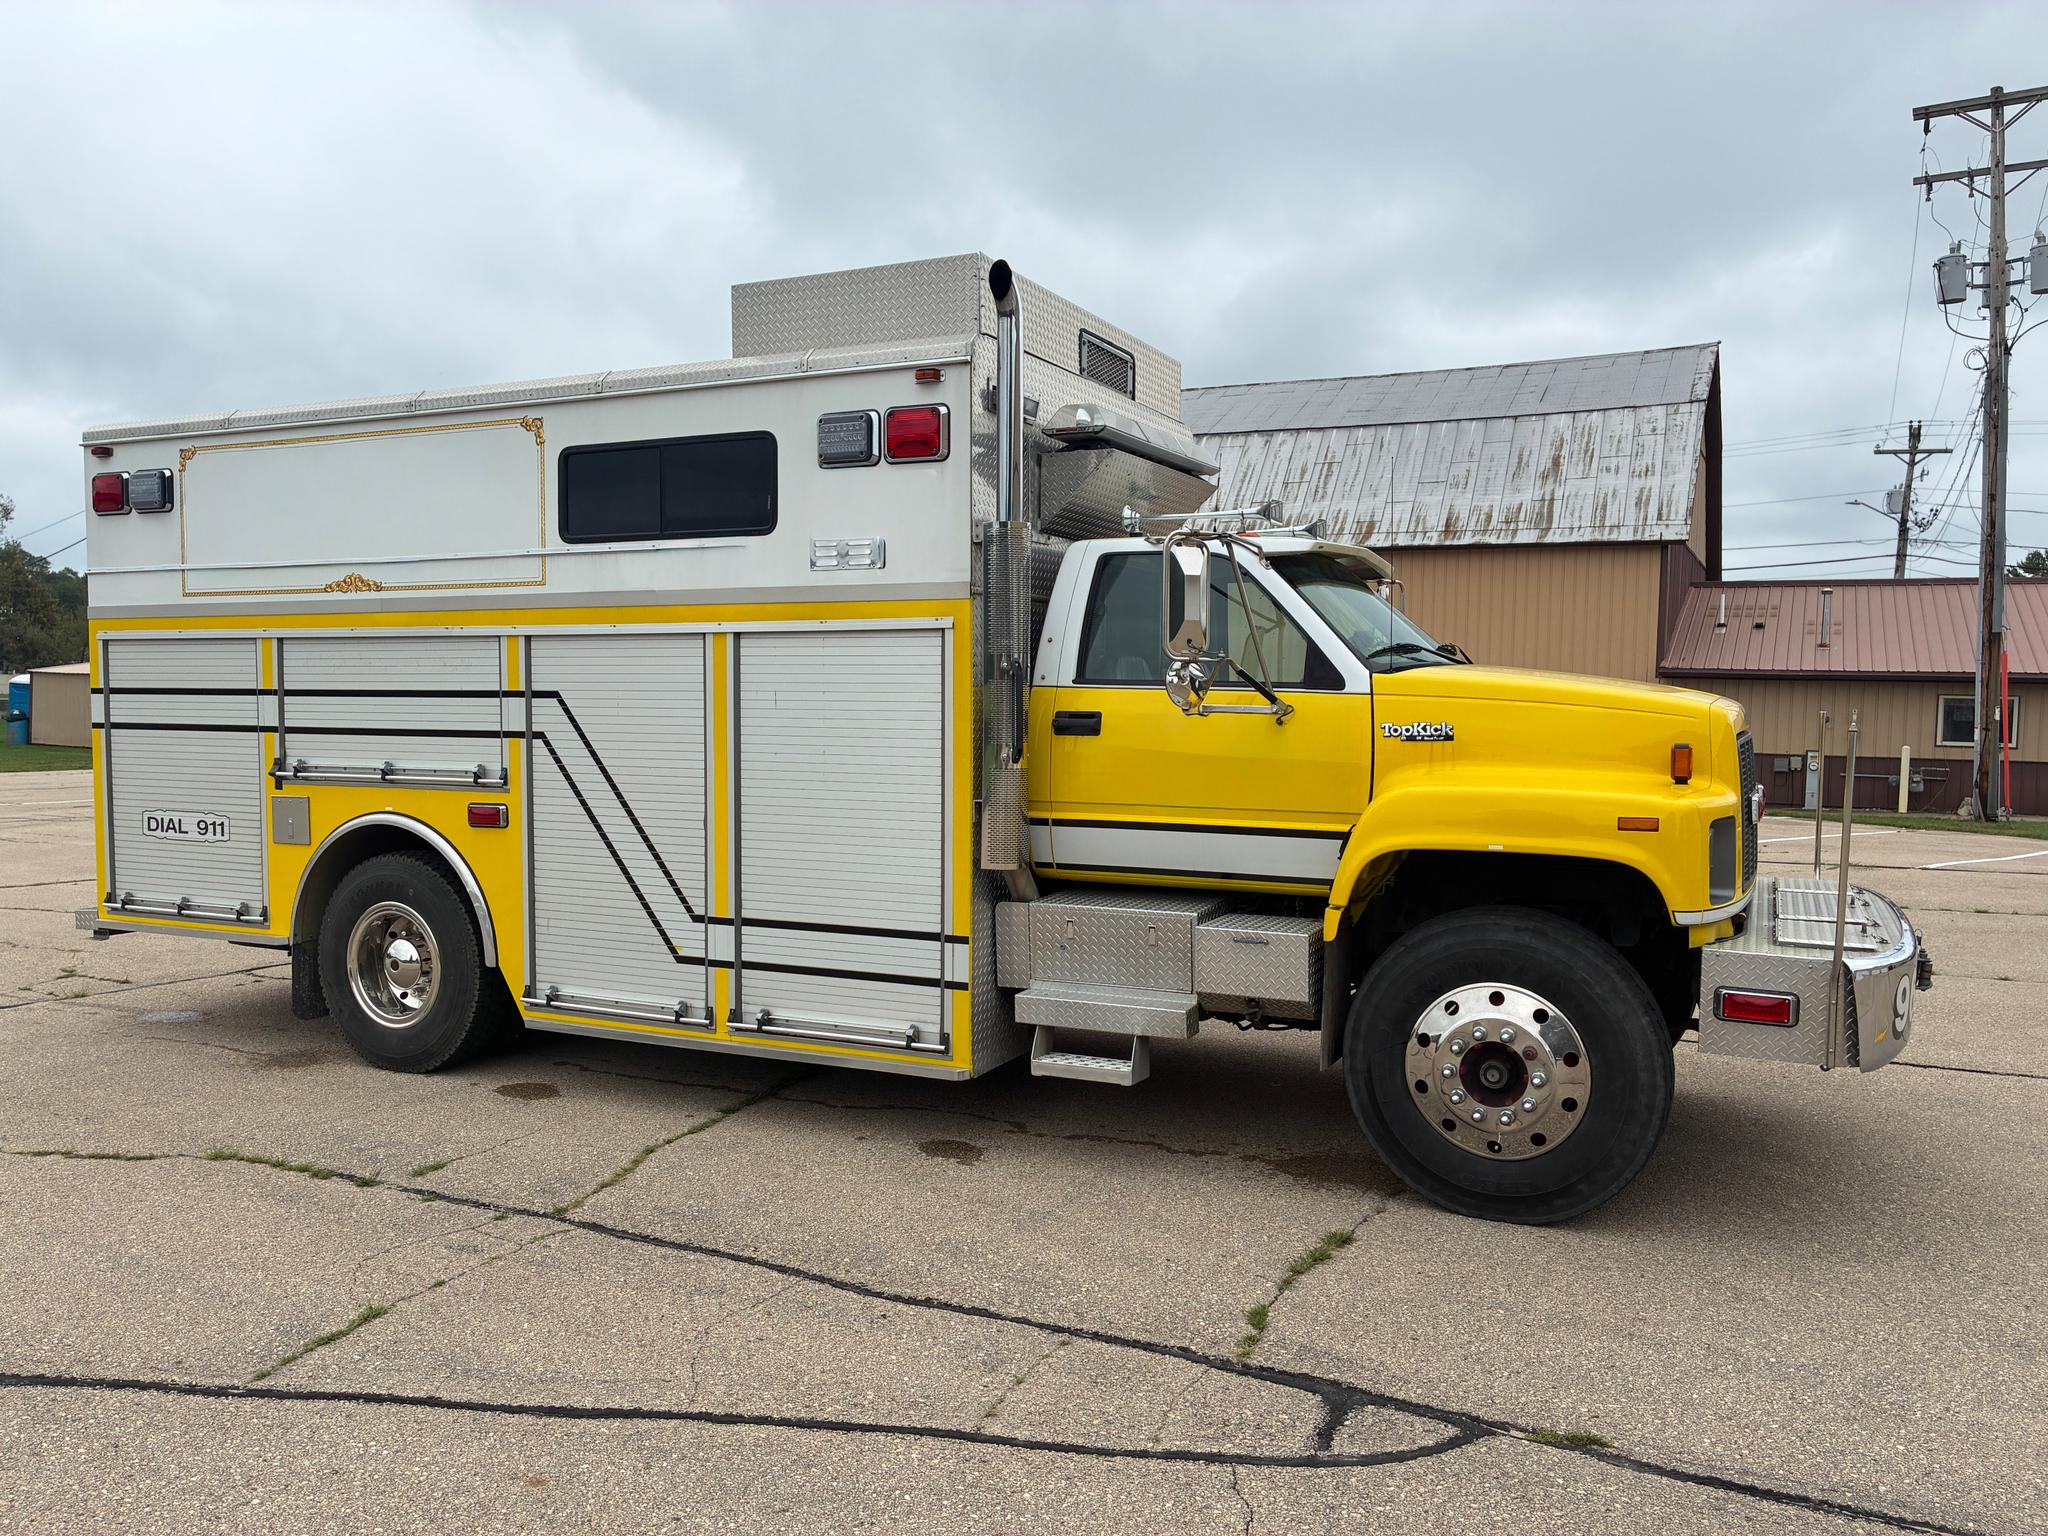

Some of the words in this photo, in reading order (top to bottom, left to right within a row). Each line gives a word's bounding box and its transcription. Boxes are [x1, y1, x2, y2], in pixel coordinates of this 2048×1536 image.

[1380, 721, 1454, 740] TopKick
[147, 816, 189, 834] DIAL
[196, 819, 225, 837] 911
[1893, 971, 1915, 1036] 9
